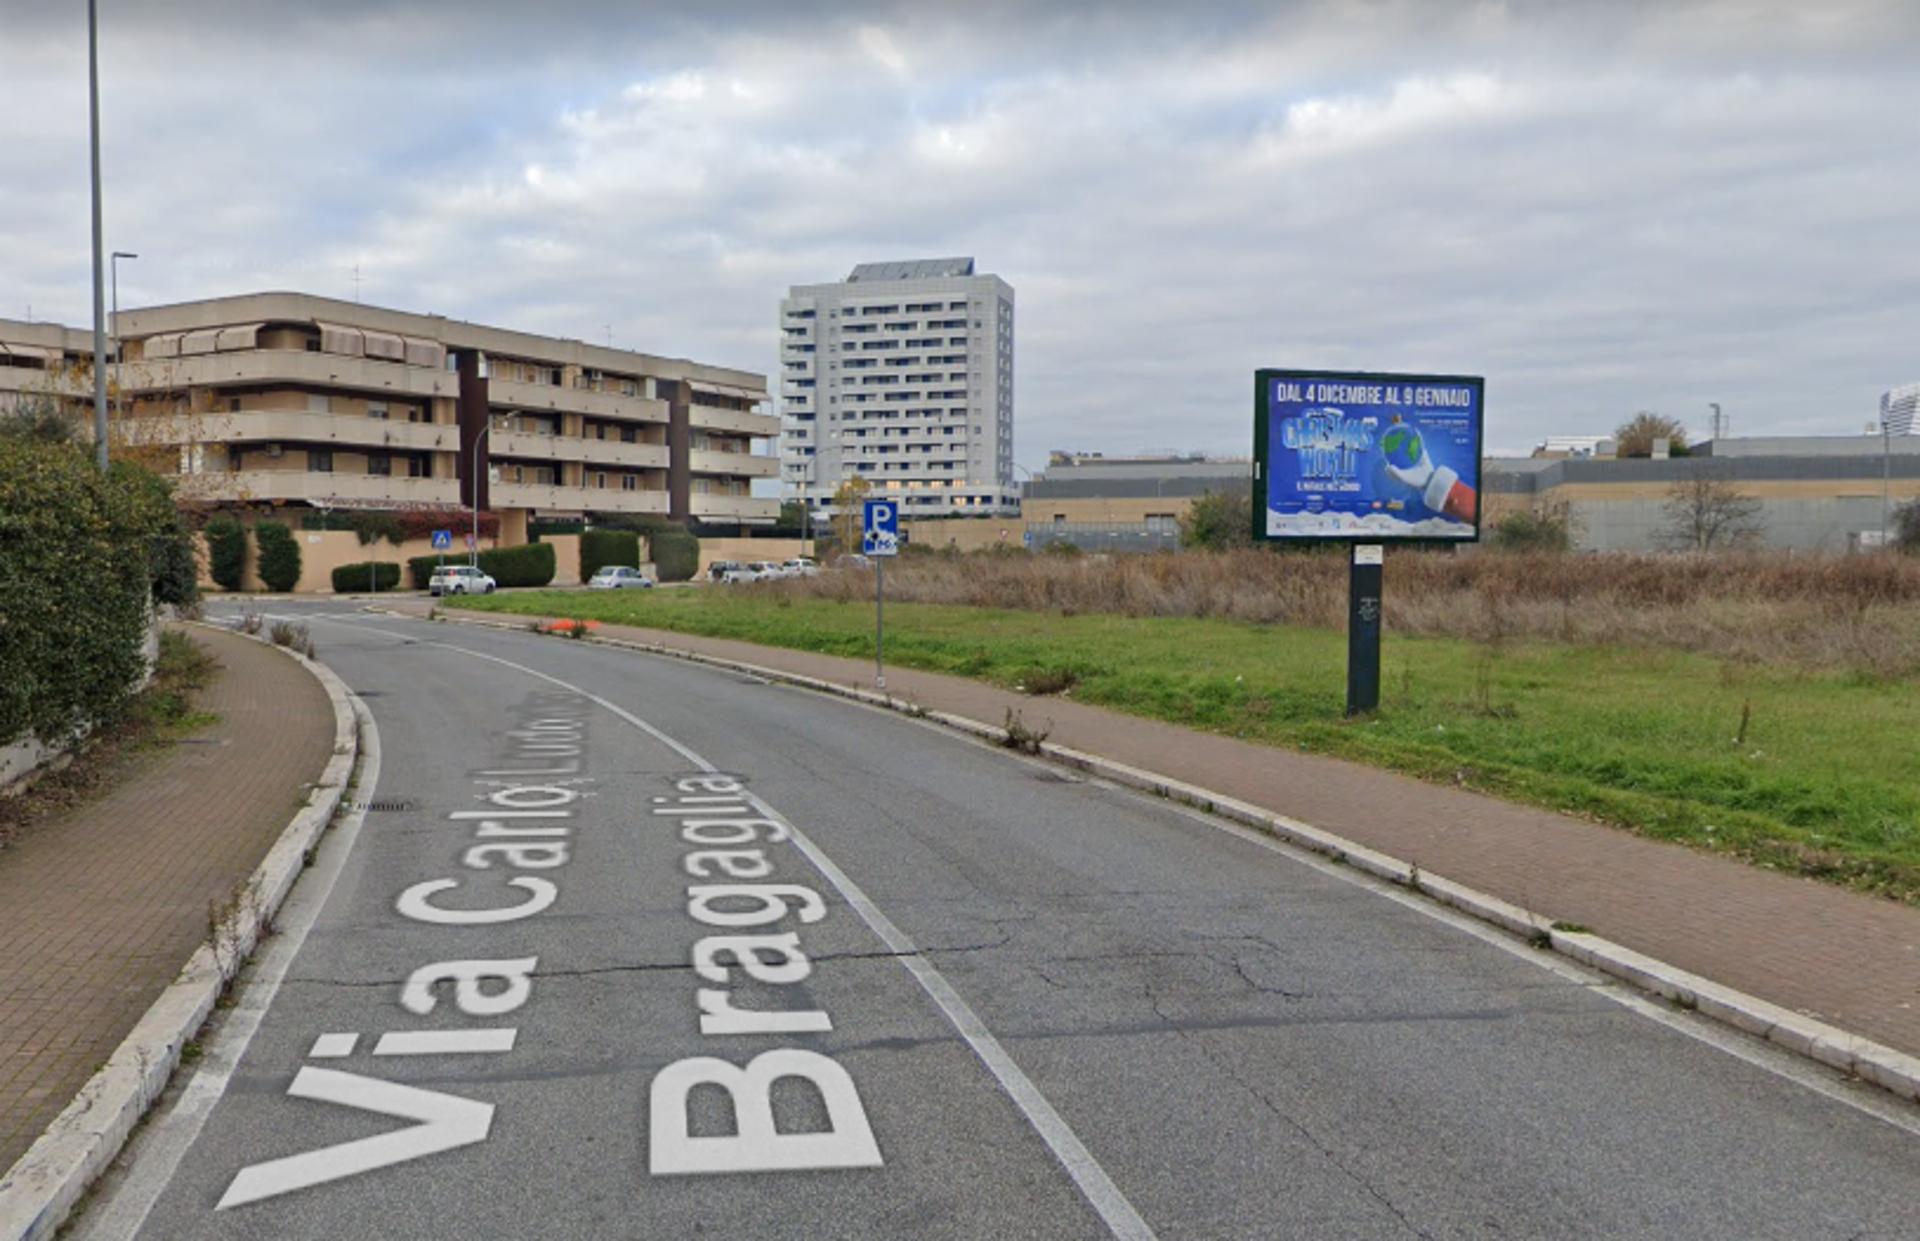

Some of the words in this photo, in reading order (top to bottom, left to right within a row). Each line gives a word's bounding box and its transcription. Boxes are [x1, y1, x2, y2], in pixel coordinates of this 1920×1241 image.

[1277, 383, 1303, 403] DAL
[1306, 384, 1315, 403] 4
[1317, 384, 1384, 405] DICEMBRE
[1385, 386, 1400, 405] AL
[1404, 387, 1414, 405] 9
[1415, 388, 1471, 408] GENNAIO
[872, 504, 892, 531] P
